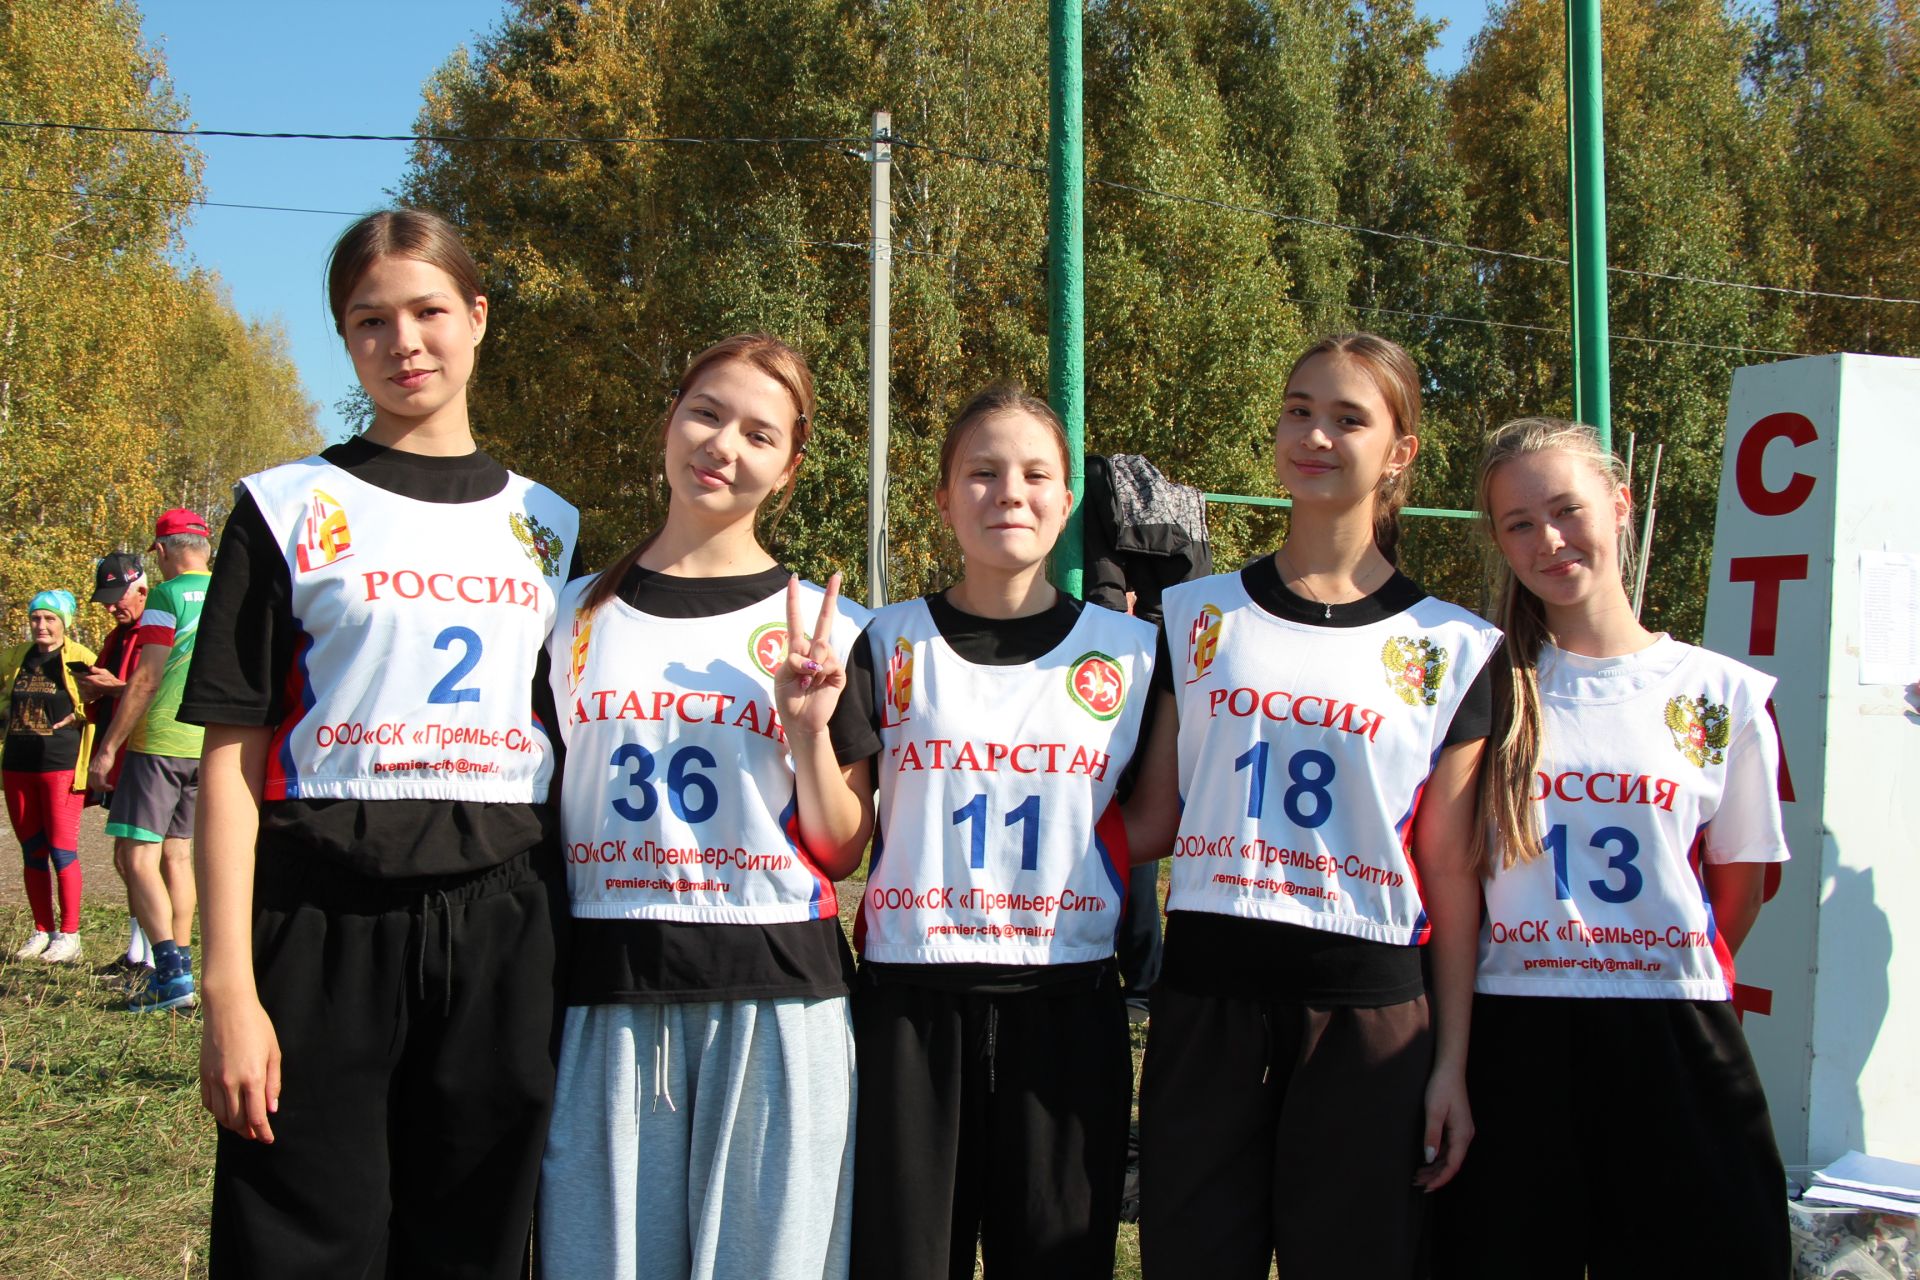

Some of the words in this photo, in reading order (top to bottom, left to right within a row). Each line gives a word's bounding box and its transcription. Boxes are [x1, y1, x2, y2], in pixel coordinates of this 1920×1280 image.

[361, 569, 540, 612] РОССИЯ
[427, 626, 483, 704] 2
[316, 722, 406, 748] ООО«СК
[569, 689, 785, 744] АТАРСТАН
[1208, 687, 1386, 743] РОССИЯ
[609, 743, 719, 824] 36
[1234, 741, 1336, 829] 18
[1529, 770, 1681, 812] ОССИЯ
[632, 840, 793, 871] «Премьер-Сити»
[952, 794, 1041, 871] 11
[1212, 872, 1340, 902] remier-city@mail.ru
[1239, 838, 1405, 889] «Премьер-Сити»
[1540, 823, 1644, 904] 13
[872, 886, 954, 910] ООО«СК
[926, 923, 1057, 939] premier-city@mail.ru
[1522, 956, 1662, 973] premier-city@mail.ru
